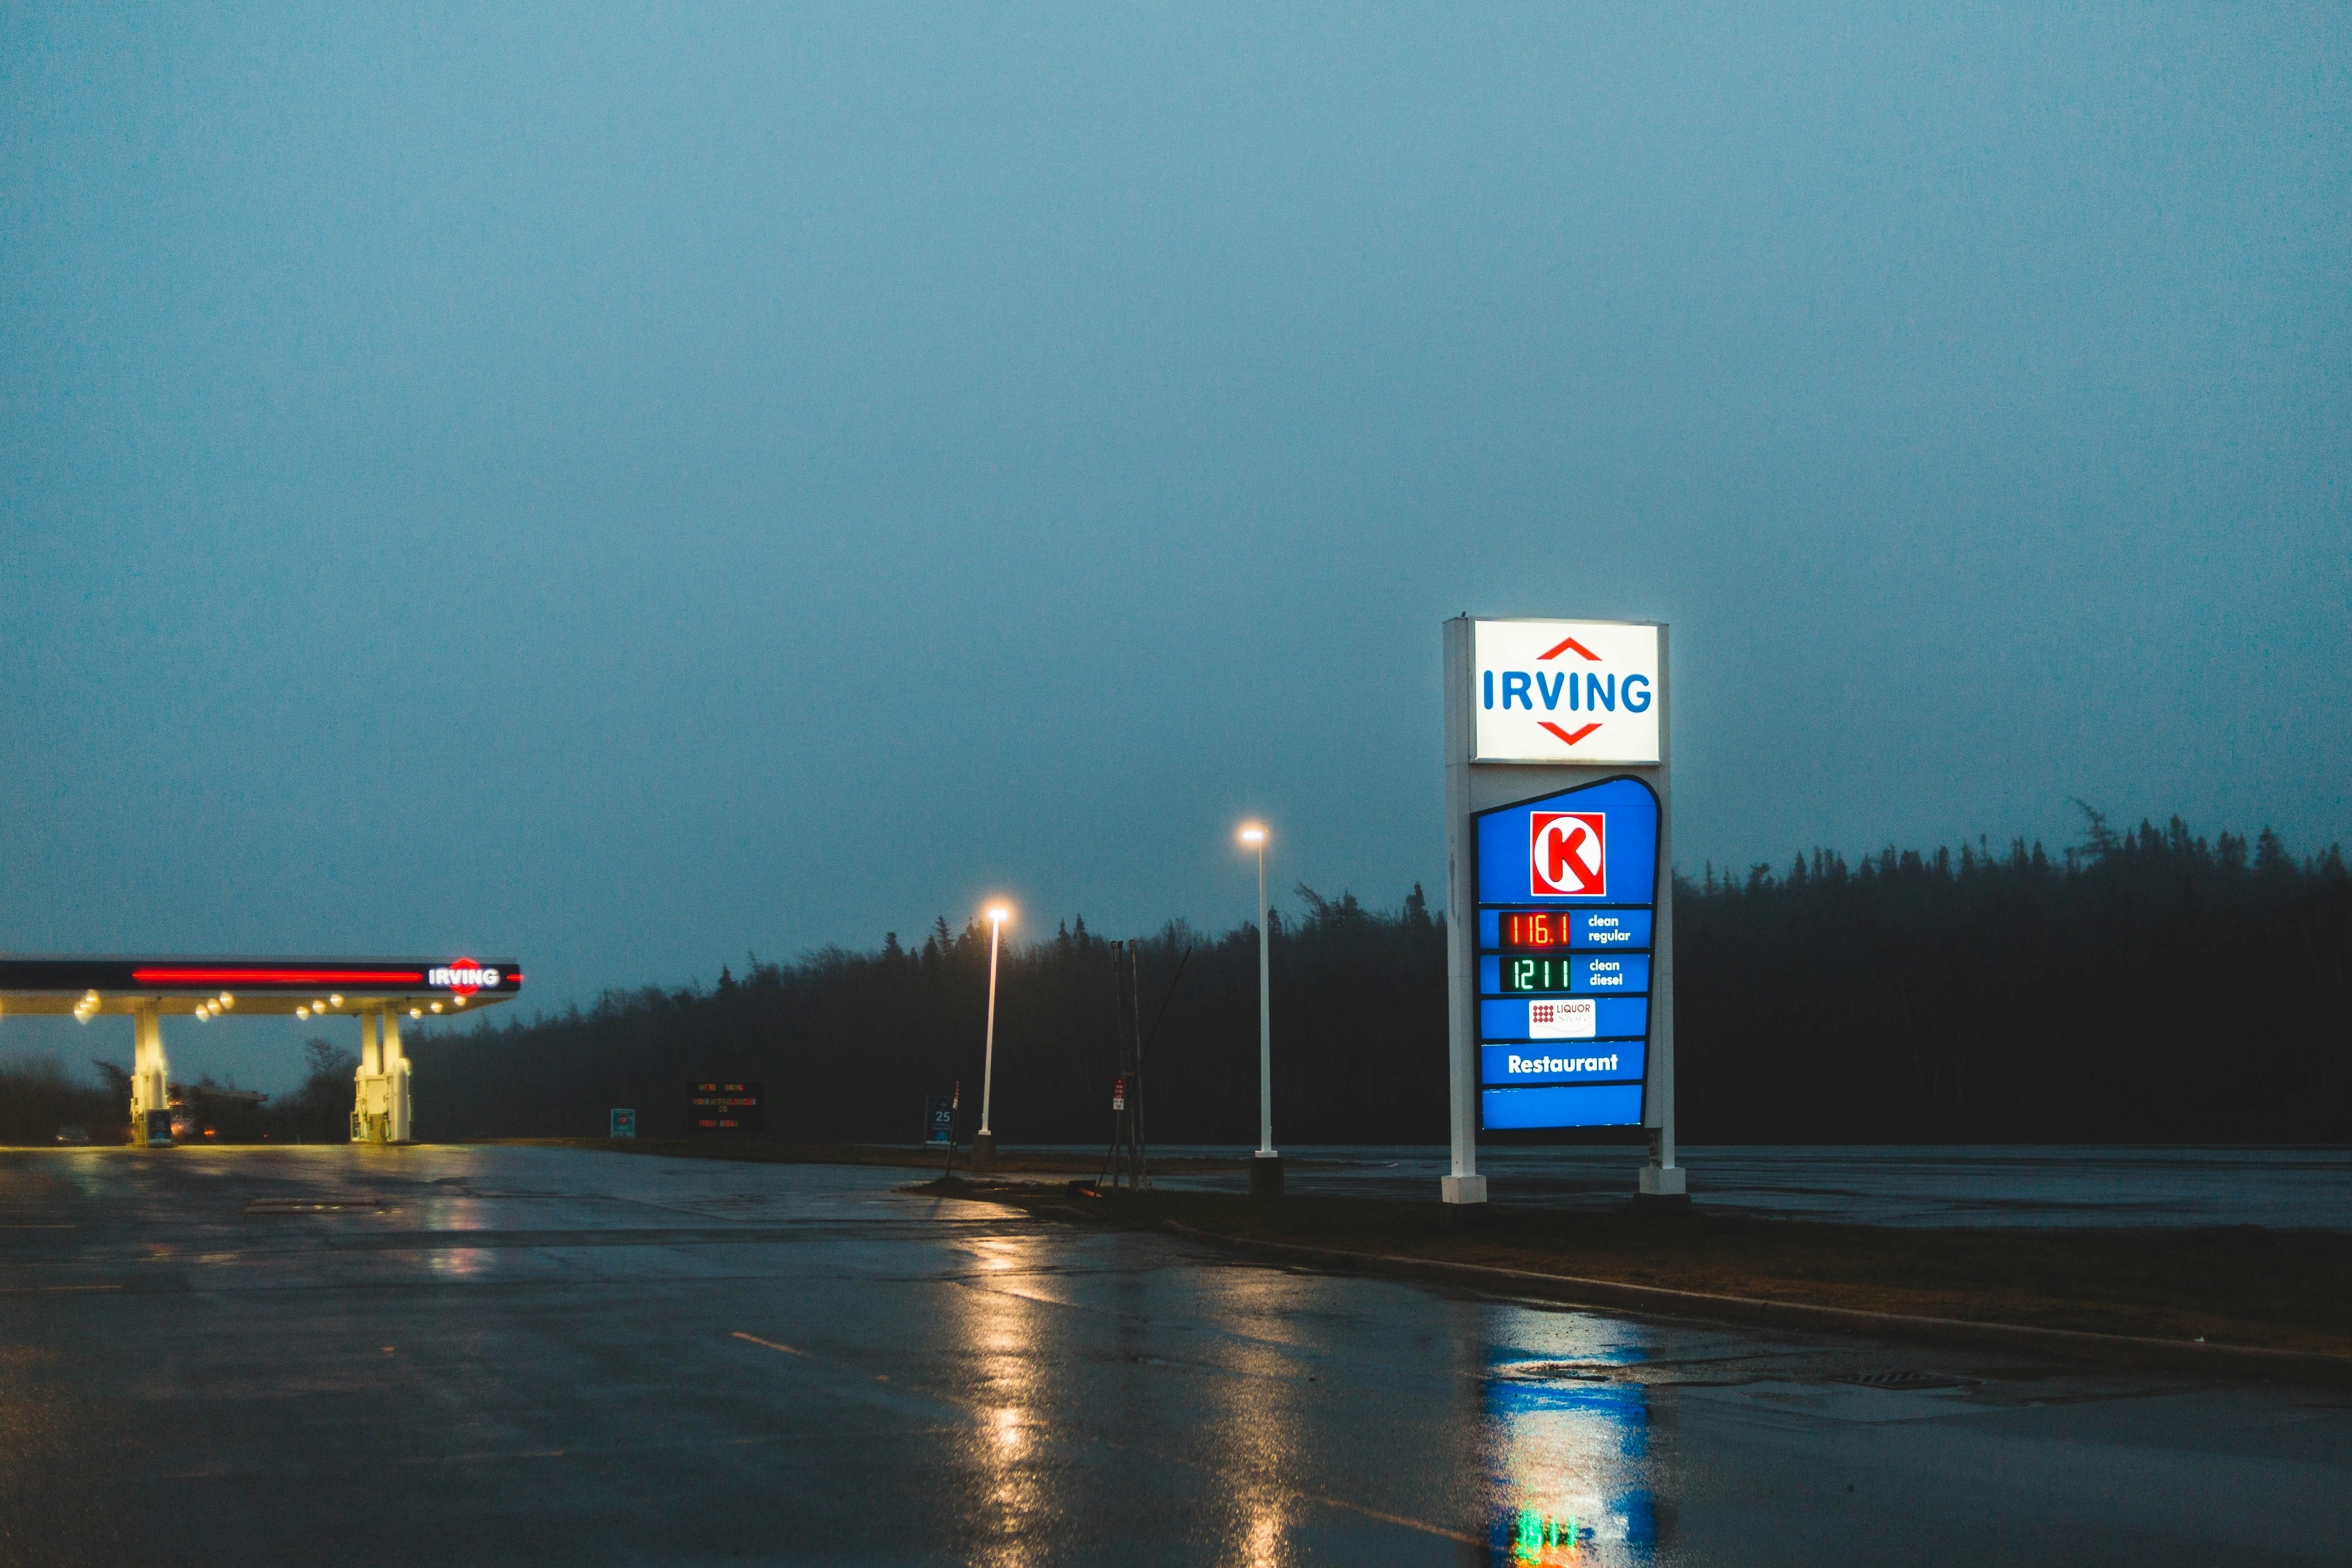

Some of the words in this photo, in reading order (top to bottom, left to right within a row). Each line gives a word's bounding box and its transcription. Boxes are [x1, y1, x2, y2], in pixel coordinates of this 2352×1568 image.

[1483, 670, 1651, 713] IRVING
[1548, 827, 1597, 887] K
[1588, 914, 1619, 926] clean
[1513, 914, 1568, 944] 116.1
[1588, 929, 1631, 943] regular
[1590, 959, 1620, 971] clean
[428, 969, 499, 985] IRVING
[1590, 973, 1623, 985] diesel
[1557, 1004, 1590, 1013] LIQUOR
[1508, 1054, 1618, 1073] Restaurant
[936, 1111, 950, 1122] 25
